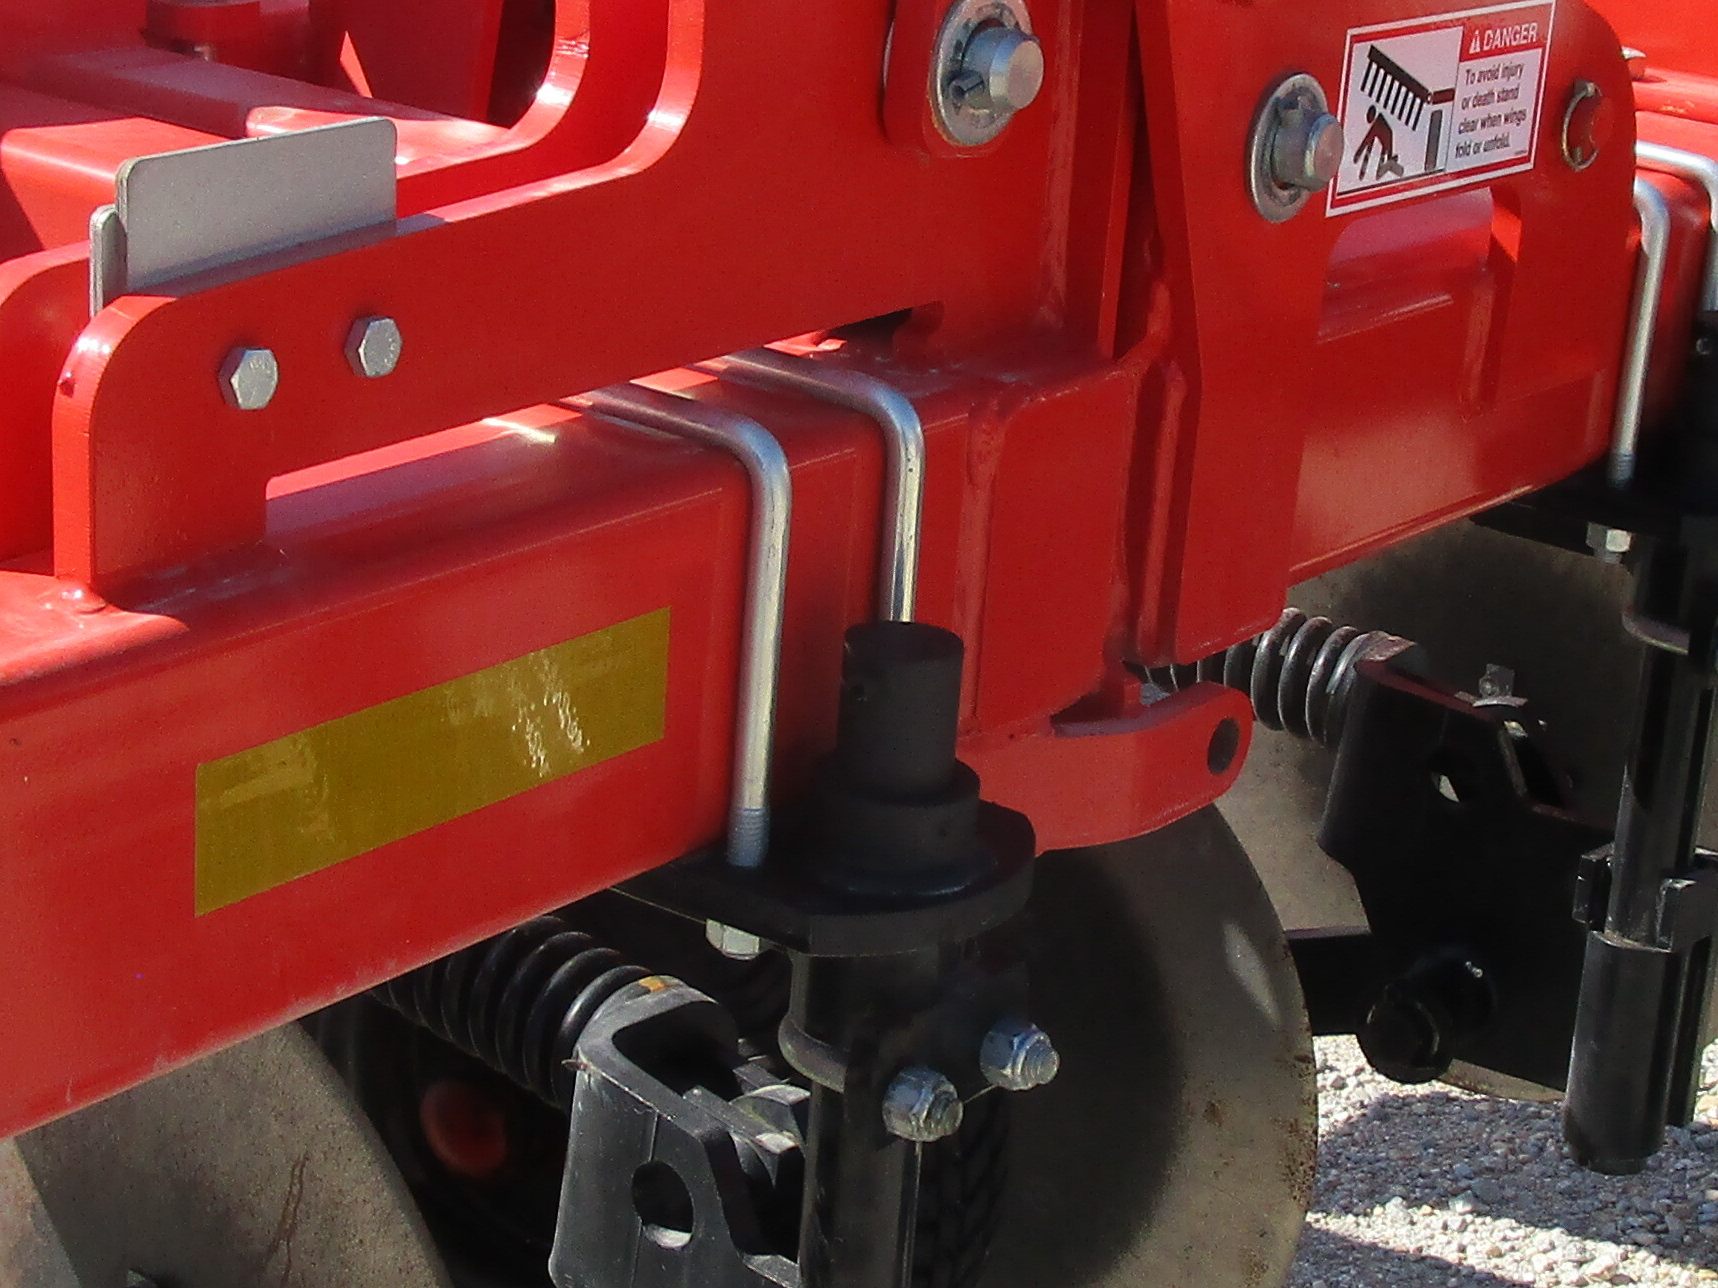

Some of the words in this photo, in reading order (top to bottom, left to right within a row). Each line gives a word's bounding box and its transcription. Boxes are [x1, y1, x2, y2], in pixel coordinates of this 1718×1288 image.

[1484, 23, 1537, 51] DANGER
[1465, 68, 1476, 85] To
[1477, 64, 1501, 84] avoid
[1501, 61, 1525, 82] injury
[1461, 96, 1472, 110] or
[1472, 90, 1495, 109] death
[1496, 83, 1520, 103] stand
[1458, 118, 1479, 135] clear
[1480, 112, 1502, 129] when
[1503, 107, 1527, 127] wings
[1455, 140, 1472, 159] fold
[1472, 141, 1483, 155] or
